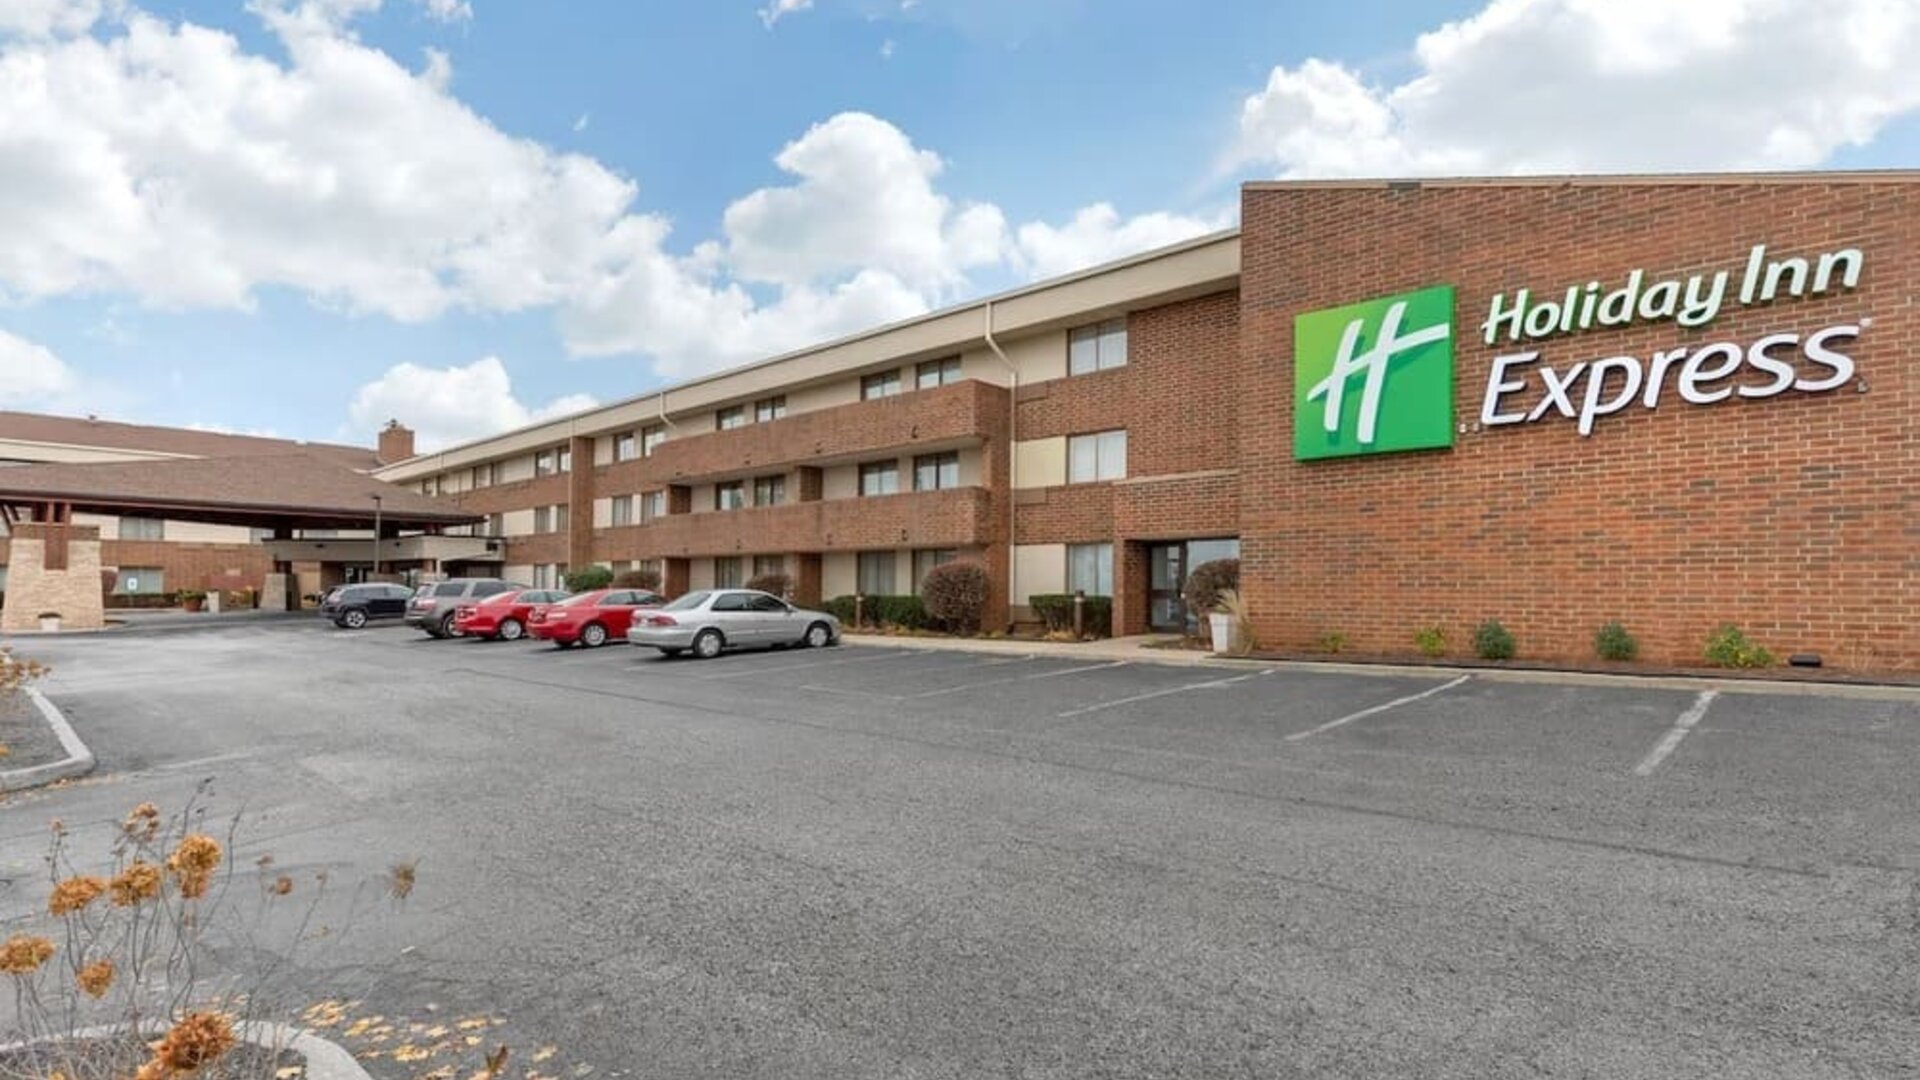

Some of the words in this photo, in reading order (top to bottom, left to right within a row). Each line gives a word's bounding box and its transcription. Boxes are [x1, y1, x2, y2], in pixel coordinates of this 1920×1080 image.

[1480, 268, 1729, 345] Holiday
[1739, 244, 1864, 304] Inn
[1480, 324, 1861, 437] Express
